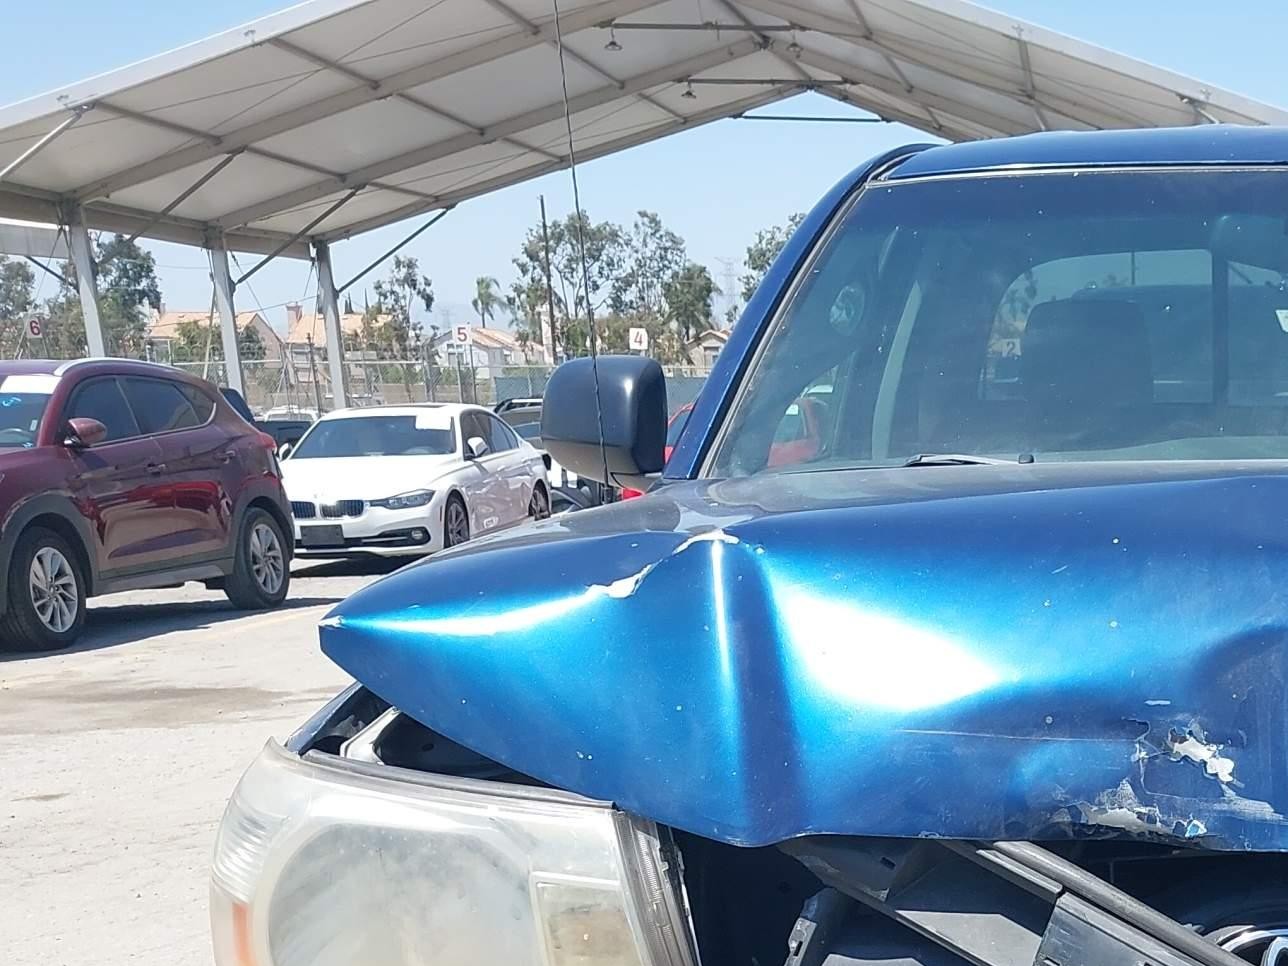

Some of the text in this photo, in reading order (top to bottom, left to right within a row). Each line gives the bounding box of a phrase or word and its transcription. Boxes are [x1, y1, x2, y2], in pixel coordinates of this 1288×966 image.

[29, 320, 41, 336] 6
[457, 327, 468, 343] 5
[633, 331, 643, 347] 4
